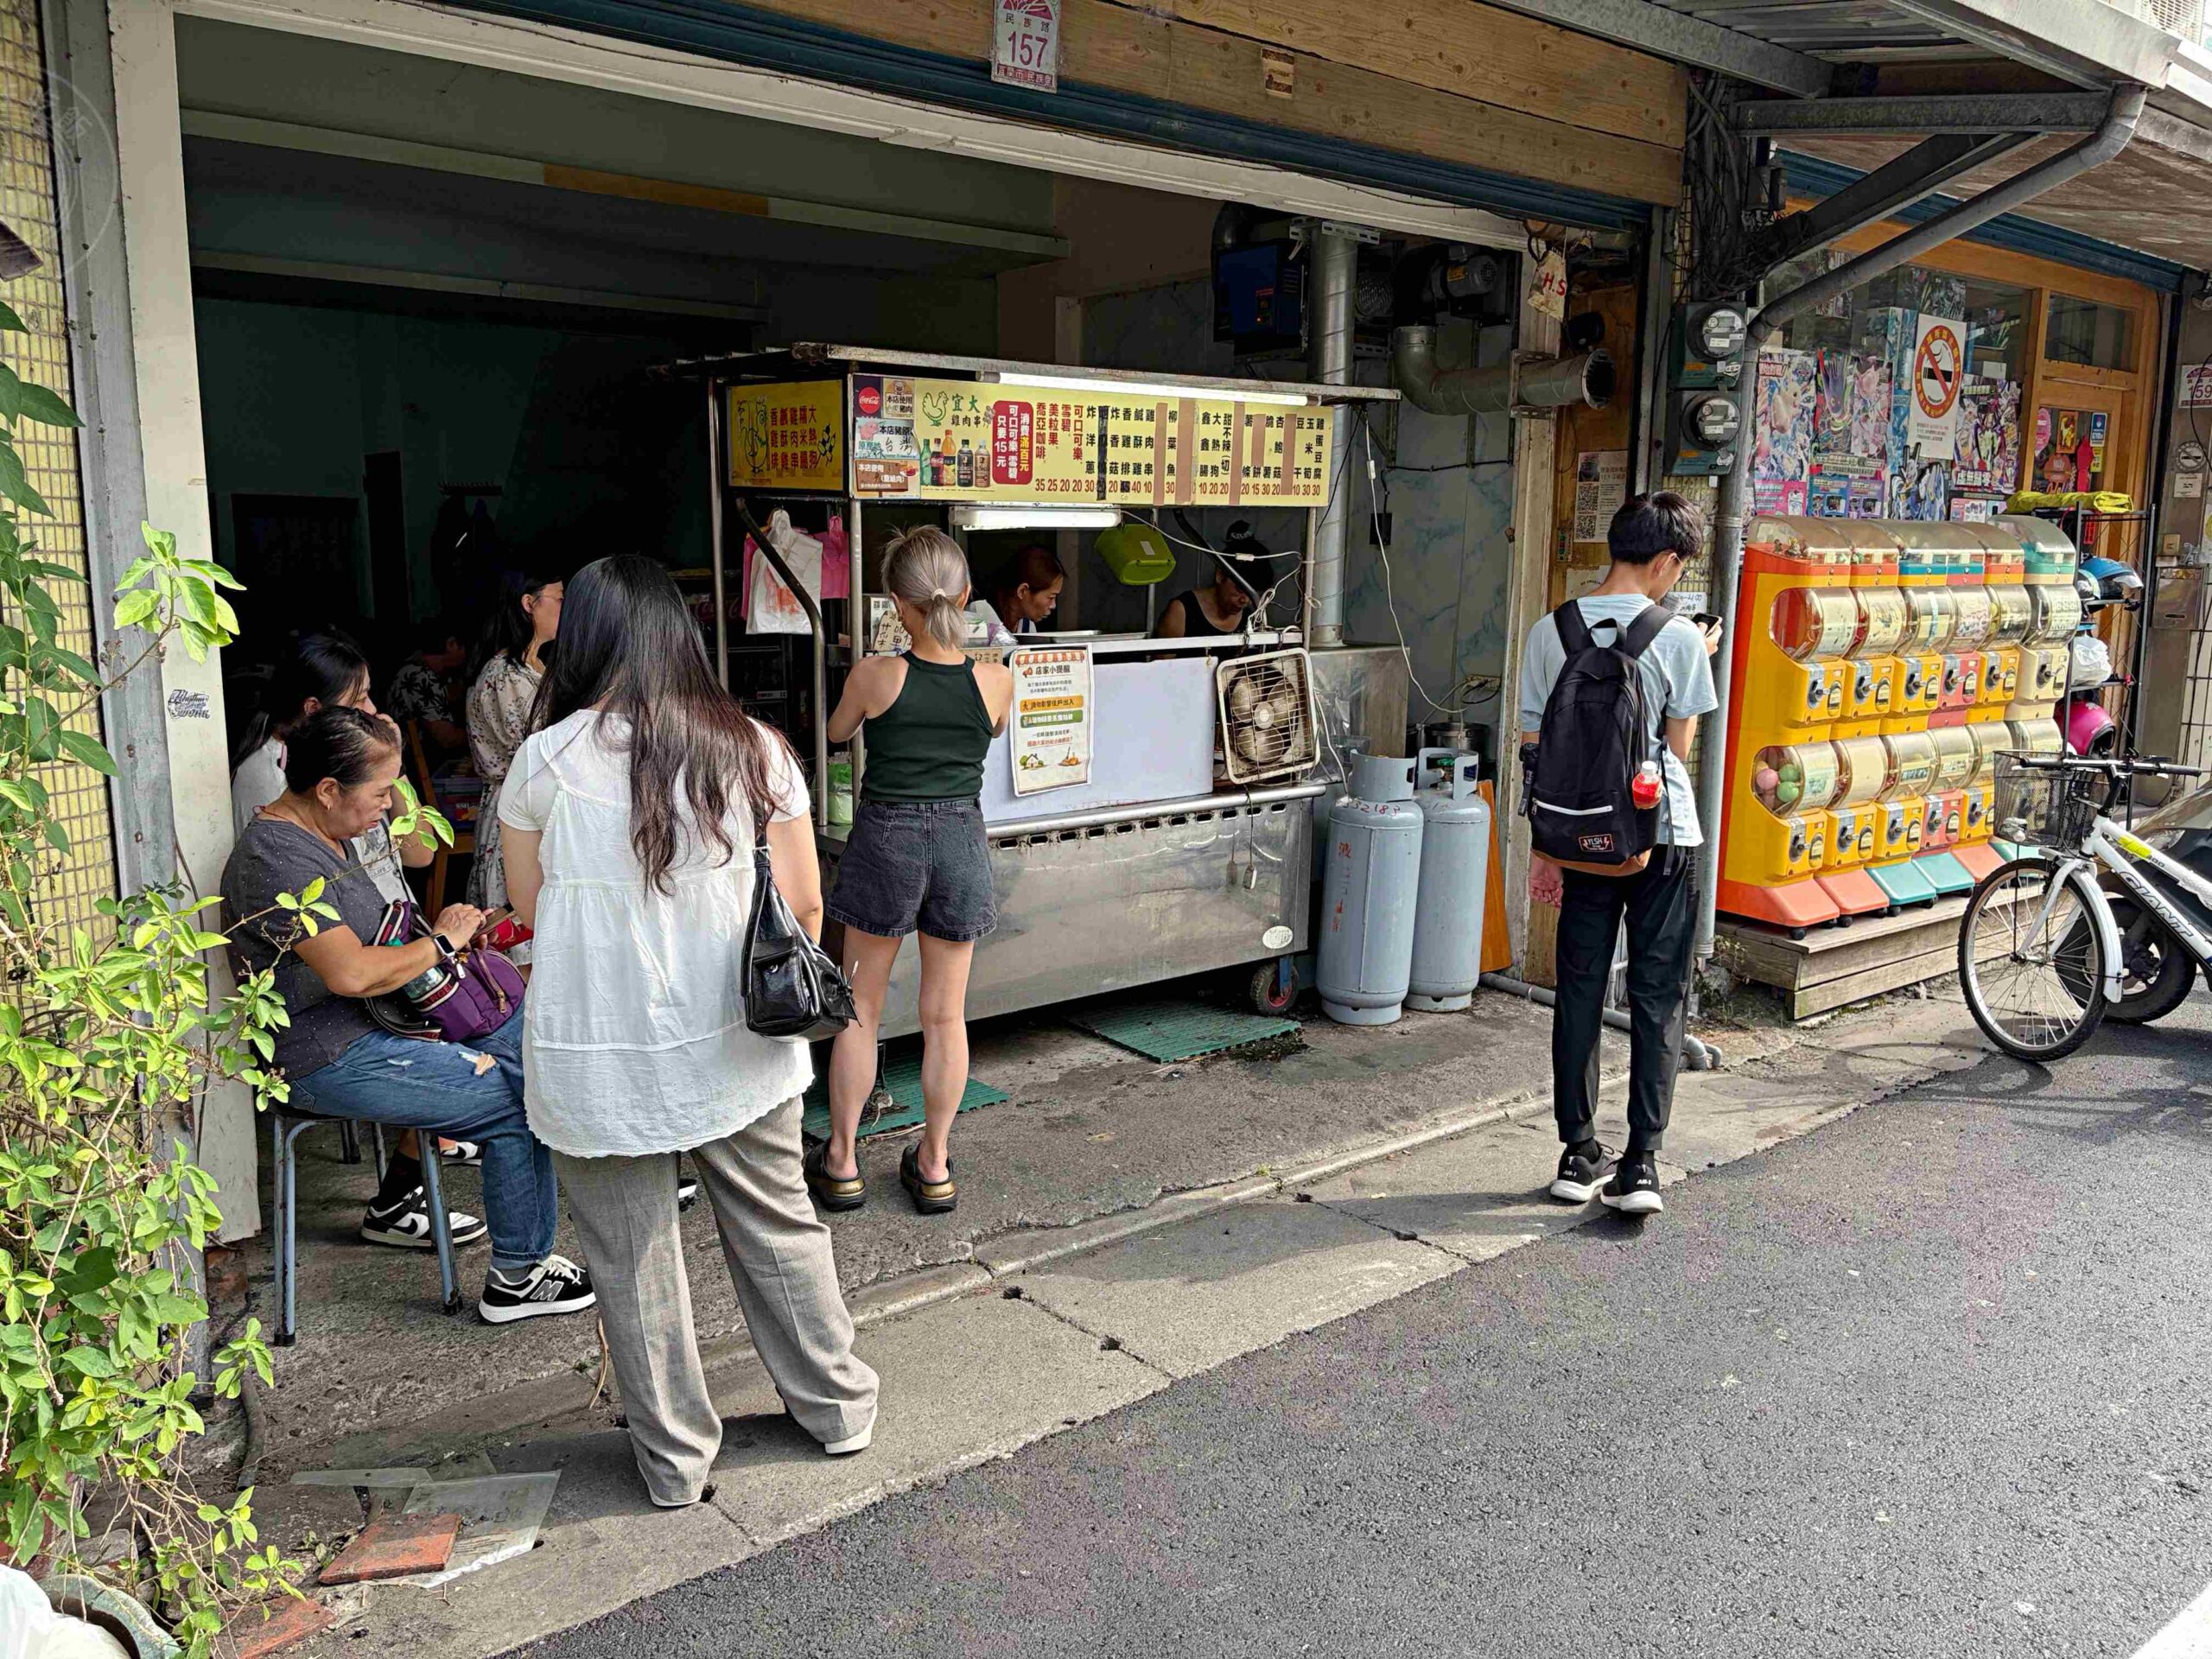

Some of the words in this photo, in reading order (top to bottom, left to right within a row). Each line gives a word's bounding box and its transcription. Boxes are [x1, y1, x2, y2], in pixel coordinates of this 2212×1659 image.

[1005, 13, 1050, 33] 民族路
[1007, 31, 1048, 68] 157
[2188, 385, 2212, 399] 159
[952, 394, 982, 414] 宜大
[951, 415, 982, 429] 雞肉串
[1020, 412, 1030, 472] 消費滿百元
[1109, 405, 1121, 475] 炸香菇
[1121, 408, 1132, 475] 香雞排
[1132, 408, 1144, 476] 鹹酥雞
[1144, 409, 1155, 476] 雞肉串
[1166, 410, 1178, 477] 柳葉魚
[1210, 412, 1222, 478] 大熱狗
[1273, 416, 1285, 480] 杏鮑菇
[1313, 418, 1325, 480] 雞蛋豆腐
[1035, 479, 1046, 492] 35
[1047, 479, 1058, 492] 25
[1060, 479, 1070, 493] 20
[1072, 480, 1082, 493] 20
[1084, 480, 1095, 493] 30
[1109, 480, 1118, 493] 20
[1132, 480, 1141, 493] 40
[1144, 480, 1153, 493] 10
[1166, 481, 1175, 494] 30
[1199, 482, 1207, 494] 10
[1210, 483, 1218, 494] 20
[1220, 483, 1229, 494] 20
[1241, 484, 1249, 495] 20
[1253, 484, 1260, 495] 15
[1262, 485, 1270, 495] 30
[1272, 485, 1281, 496] 20
[1293, 485, 1300, 495] 10
[1302, 485, 1311, 496] 30
[1312, 485, 1320, 496] 30
[1035, 664, 1071, 675] 店家小提醒
[2120, 871, 2195, 938] GIANT
